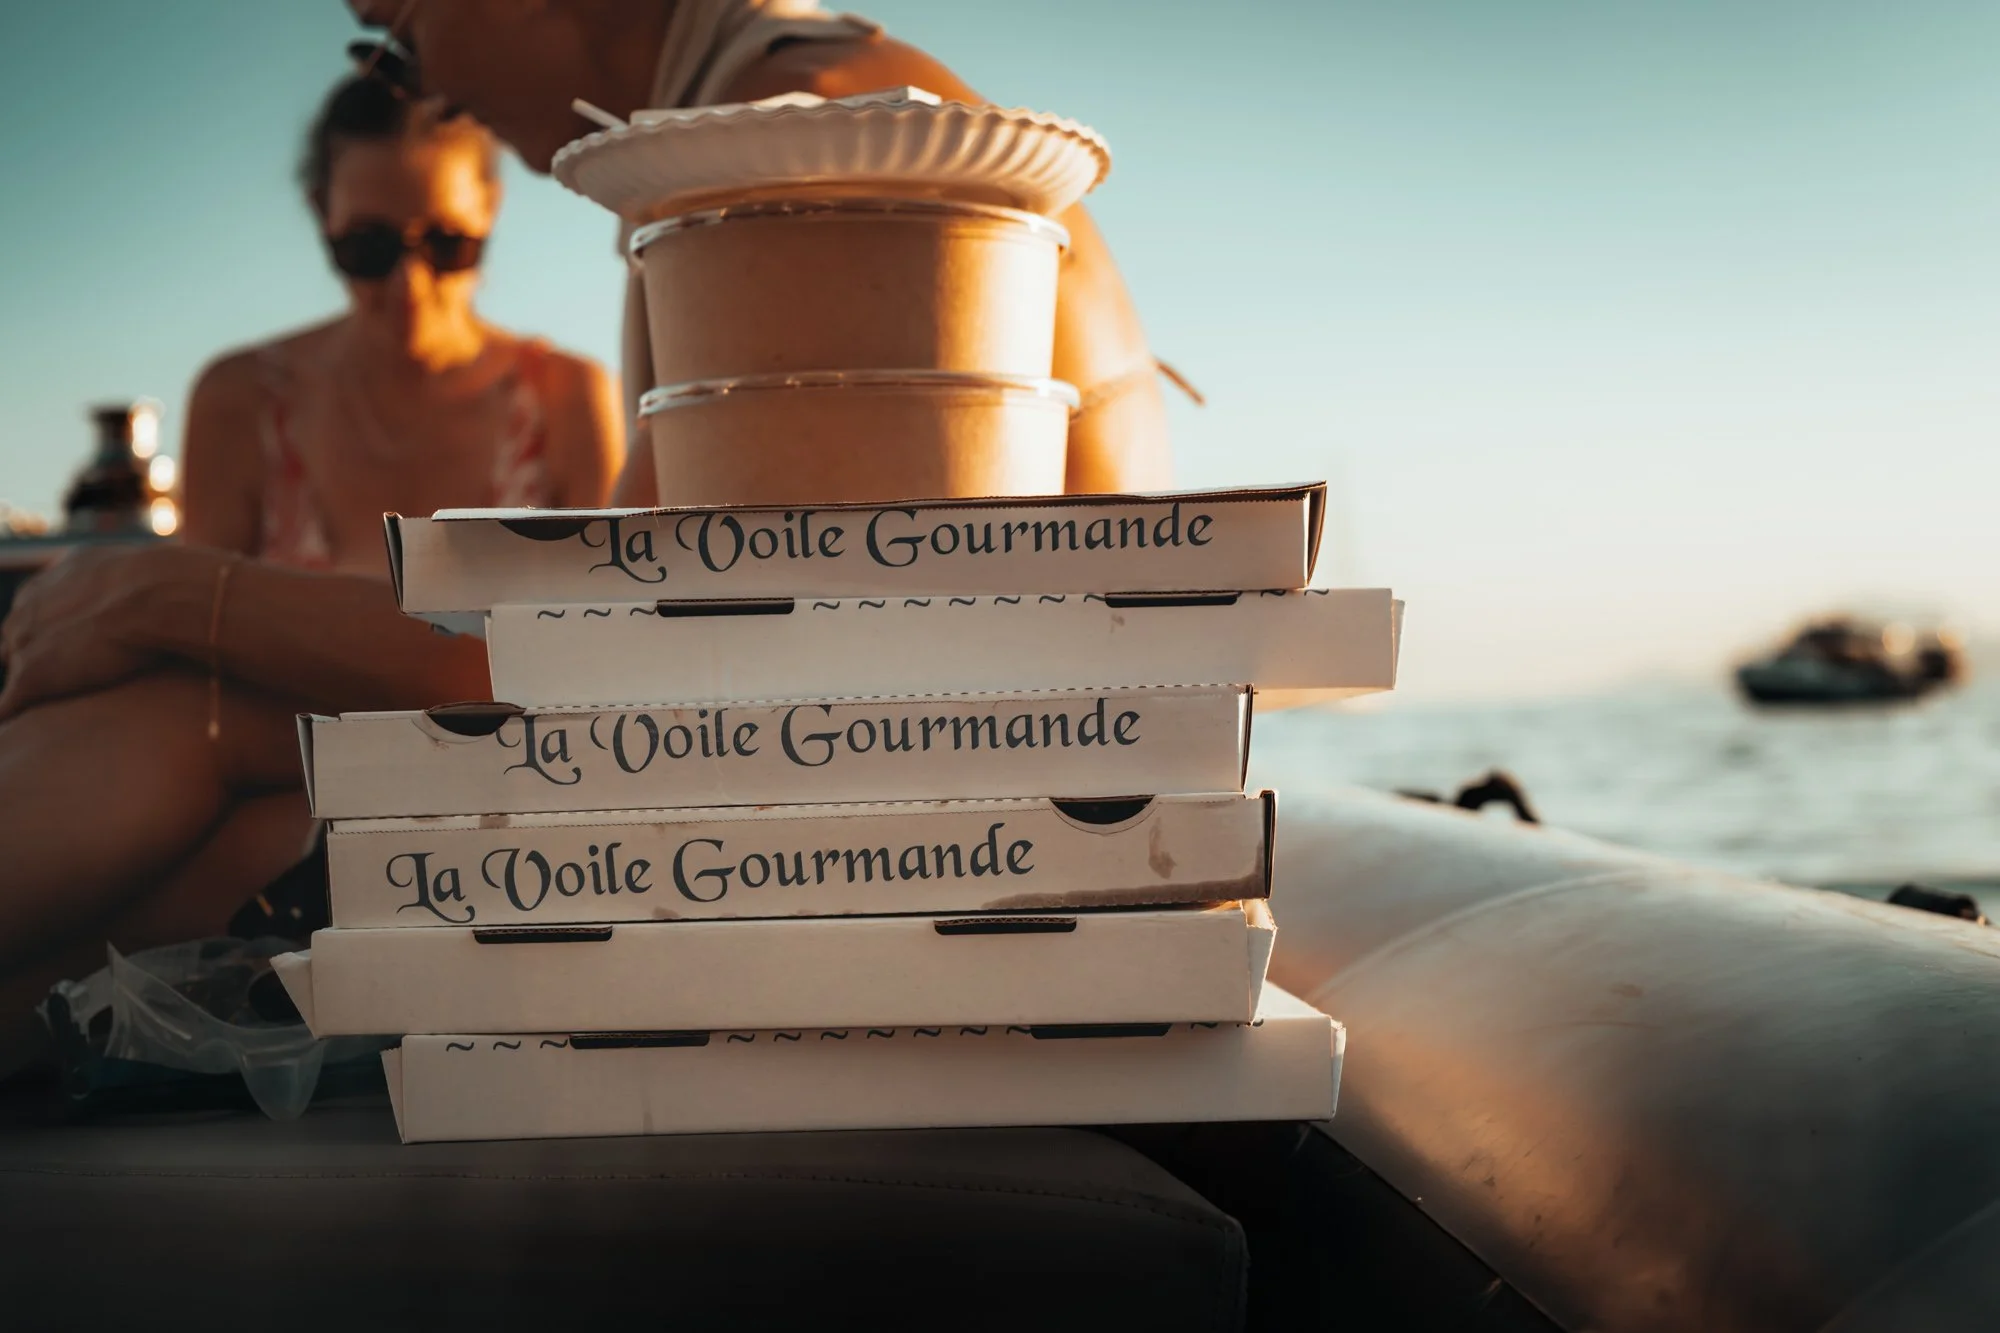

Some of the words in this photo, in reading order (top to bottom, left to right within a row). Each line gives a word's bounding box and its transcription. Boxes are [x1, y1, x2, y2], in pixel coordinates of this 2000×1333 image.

[580, 517, 667, 583] La
[675, 511, 847, 573] Voile
[866, 502, 1214, 567] Gourmande
[496, 714, 582, 785] La
[590, 707, 760, 774] Voile
[781, 697, 1141, 766] Gourmande
[386, 852, 475, 923] La
[481, 842, 653, 911] Voile
[672, 822, 1035, 902] Gourmande
